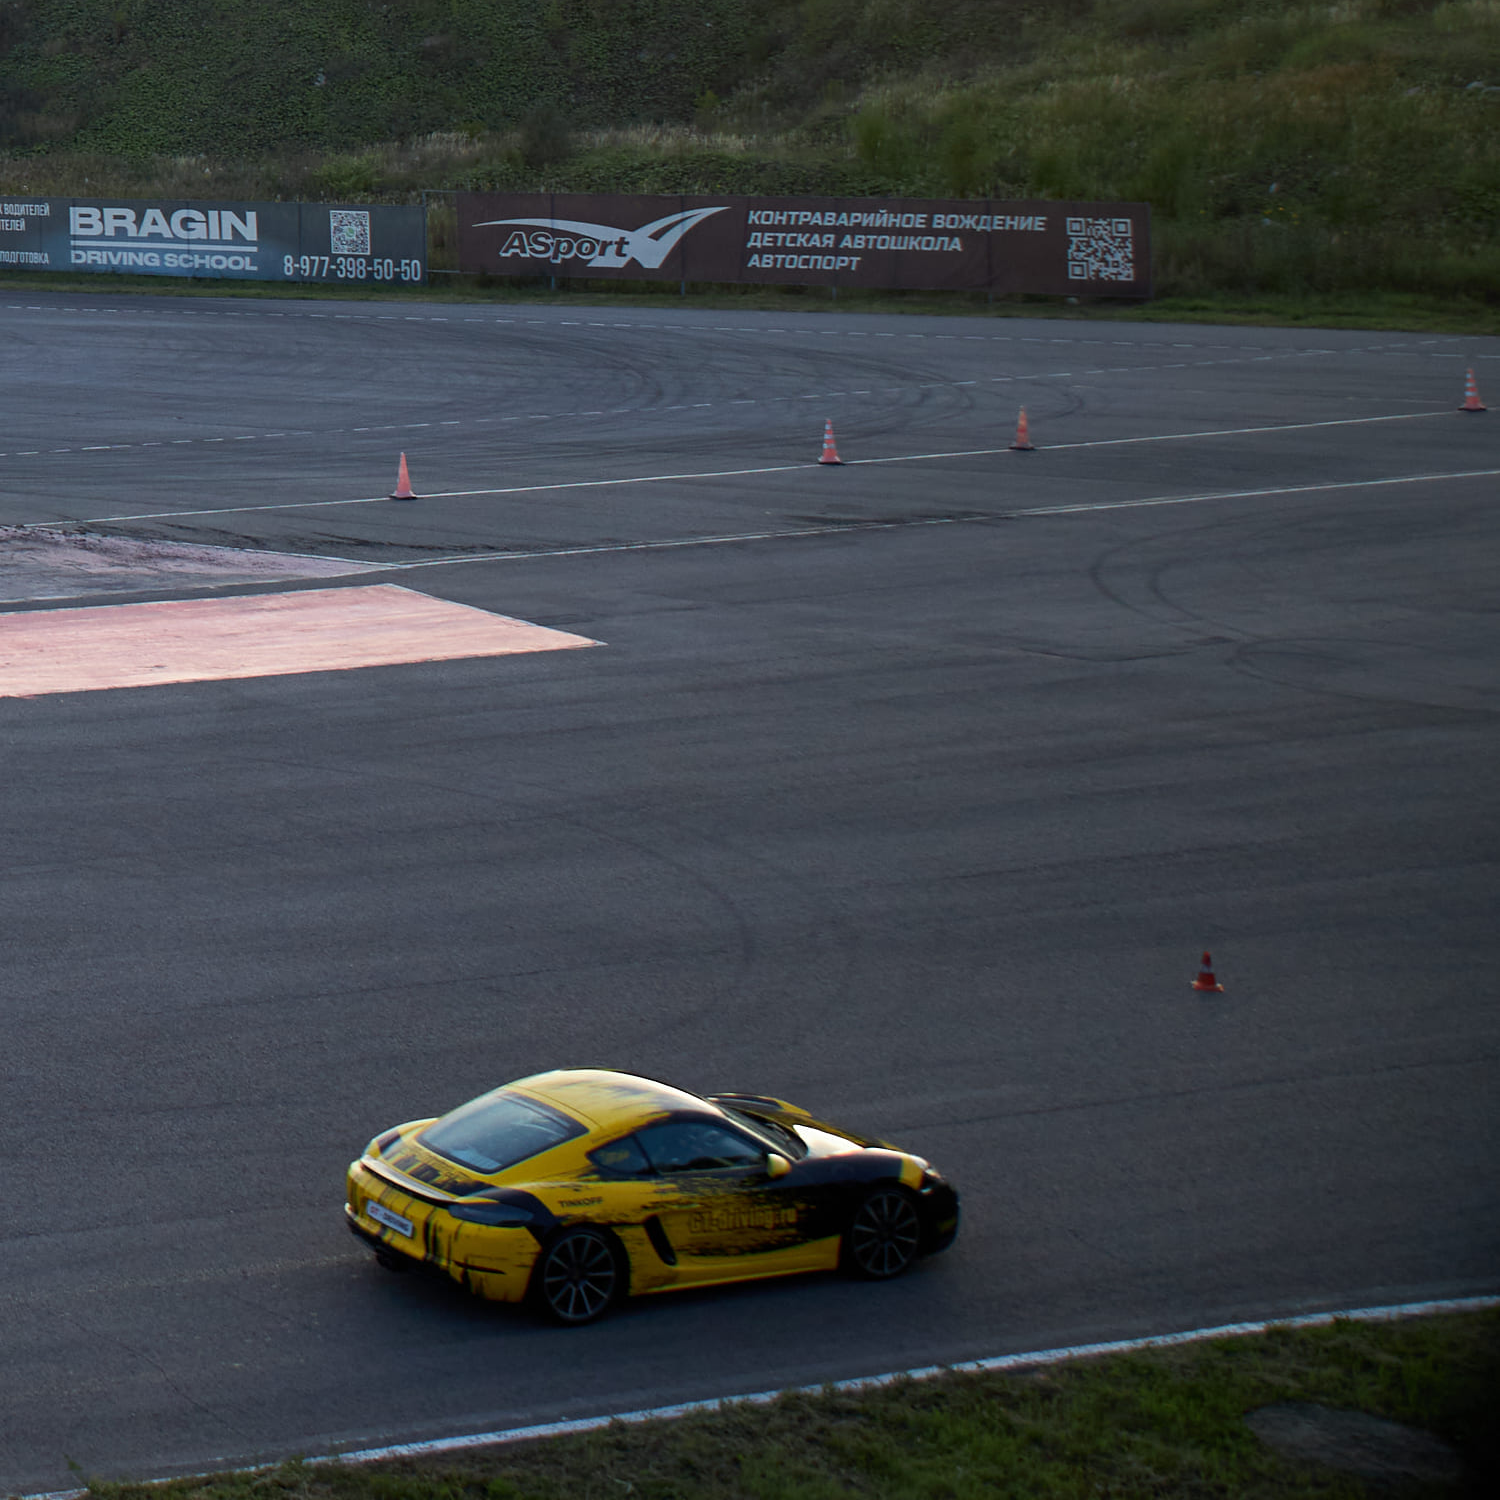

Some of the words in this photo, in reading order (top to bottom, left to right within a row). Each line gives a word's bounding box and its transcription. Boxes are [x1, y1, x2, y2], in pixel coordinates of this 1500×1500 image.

[4, 203, 50, 217] ВОДИТЕЛЕЙ
[747, 209, 928, 229] КОНТРАВАРИЙНОЕ
[932, 213, 1048, 232] ВОЖДЕНИЕ
[69, 206, 258, 241] BRAGIN
[499, 231, 630, 264] ASport
[746, 231, 836, 249] ДЕТСКАЯ
[839, 234, 963, 252] АВТОШКОЛА
[0, 250, 50, 264] ПОДГОТОВКА
[70, 249, 161, 267] DRIVING
[163, 253, 258, 271] SCHOOL
[747, 253, 862, 271] АВТОСПОРТ
[283, 255, 422, 282] 8-977-398-50-50
